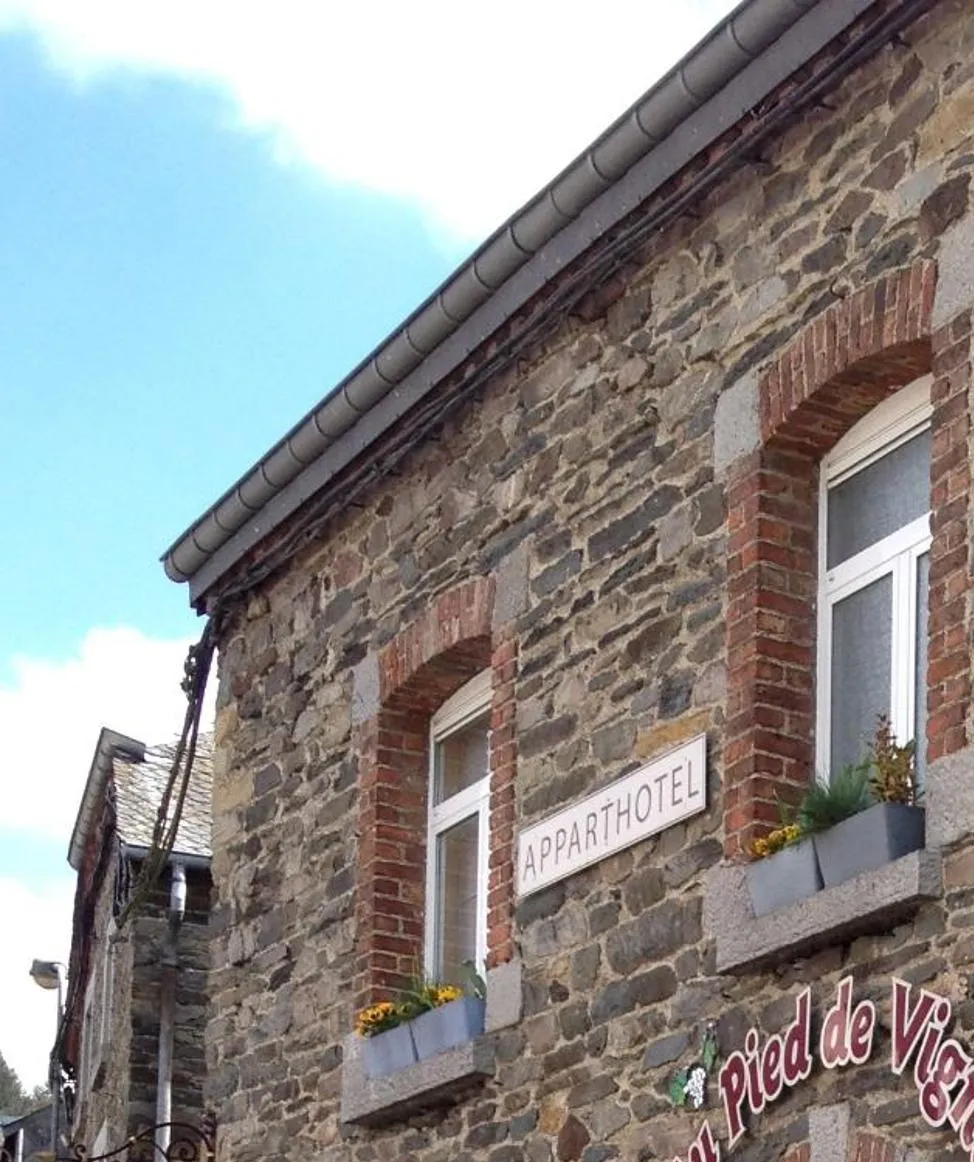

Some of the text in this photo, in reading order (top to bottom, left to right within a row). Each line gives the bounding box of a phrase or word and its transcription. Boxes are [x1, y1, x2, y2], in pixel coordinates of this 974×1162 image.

[523, 758, 700, 881] APPARTHOTEL
[719, 986, 812, 1150] Pied
[820, 975, 876, 1069] de
